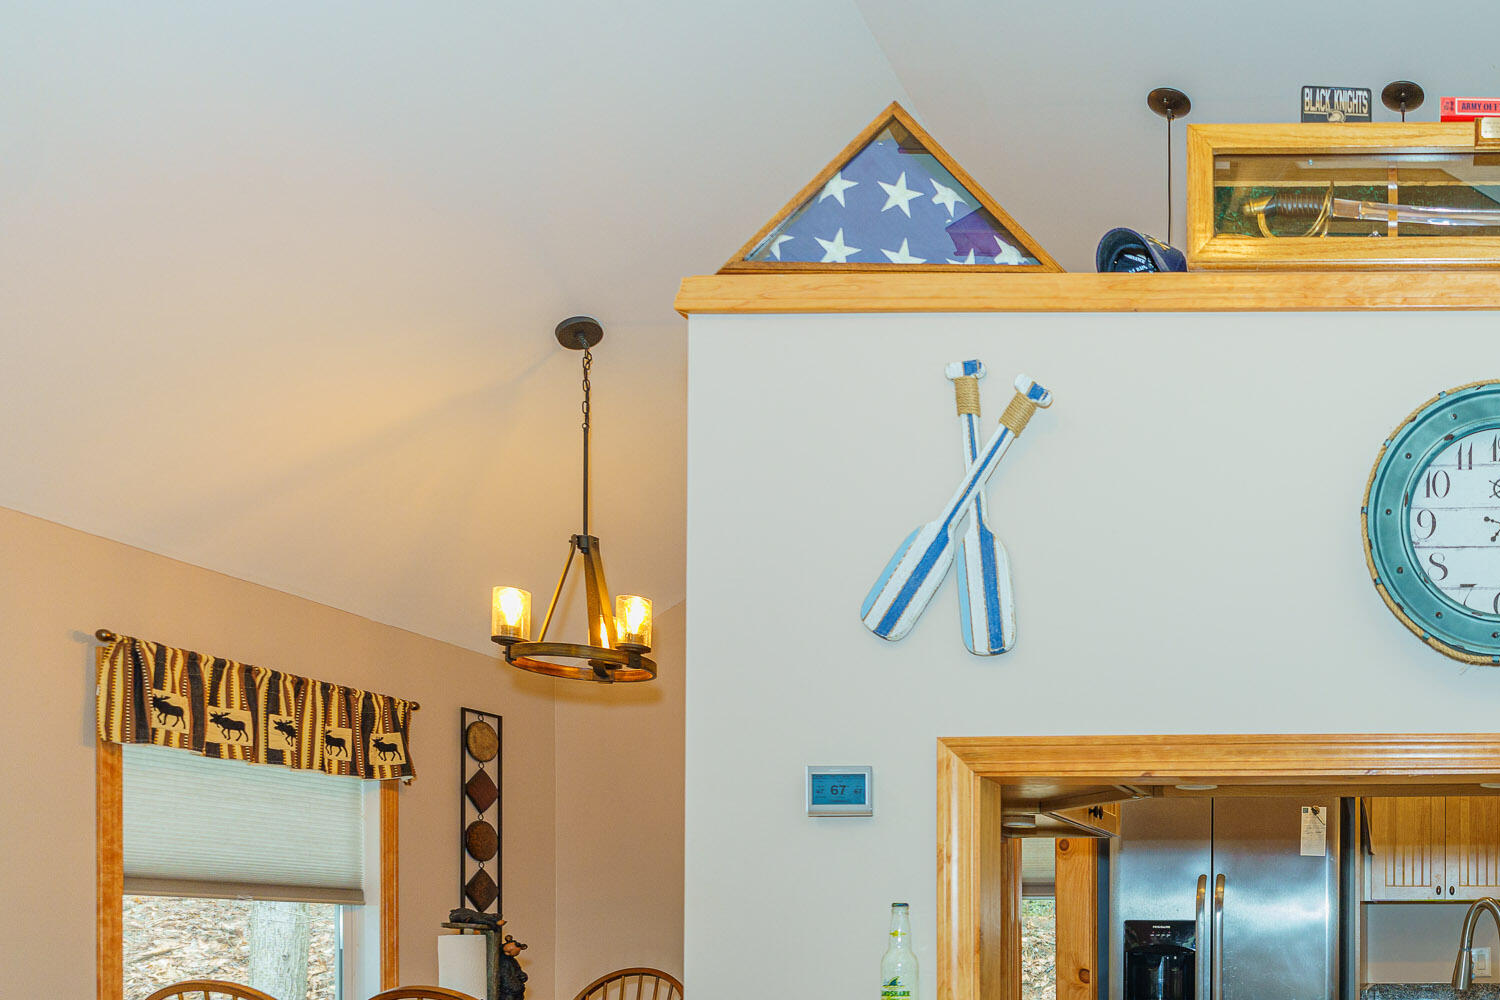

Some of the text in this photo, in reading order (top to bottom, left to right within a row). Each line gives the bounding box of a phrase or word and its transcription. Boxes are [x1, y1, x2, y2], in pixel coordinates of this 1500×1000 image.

[1304, 87, 1368, 113] BLACK KNIGHTS
[1461, 102, 1481, 110] ARMY
[1457, 441, 1473, 470] 11
[1425, 470, 1450, 498] 10
[1414, 509, 1436, 540] 9
[1428, 552, 1449, 581] 8
[1459, 583, 1477, 607] 7
[830, 785, 846, 795] 67
